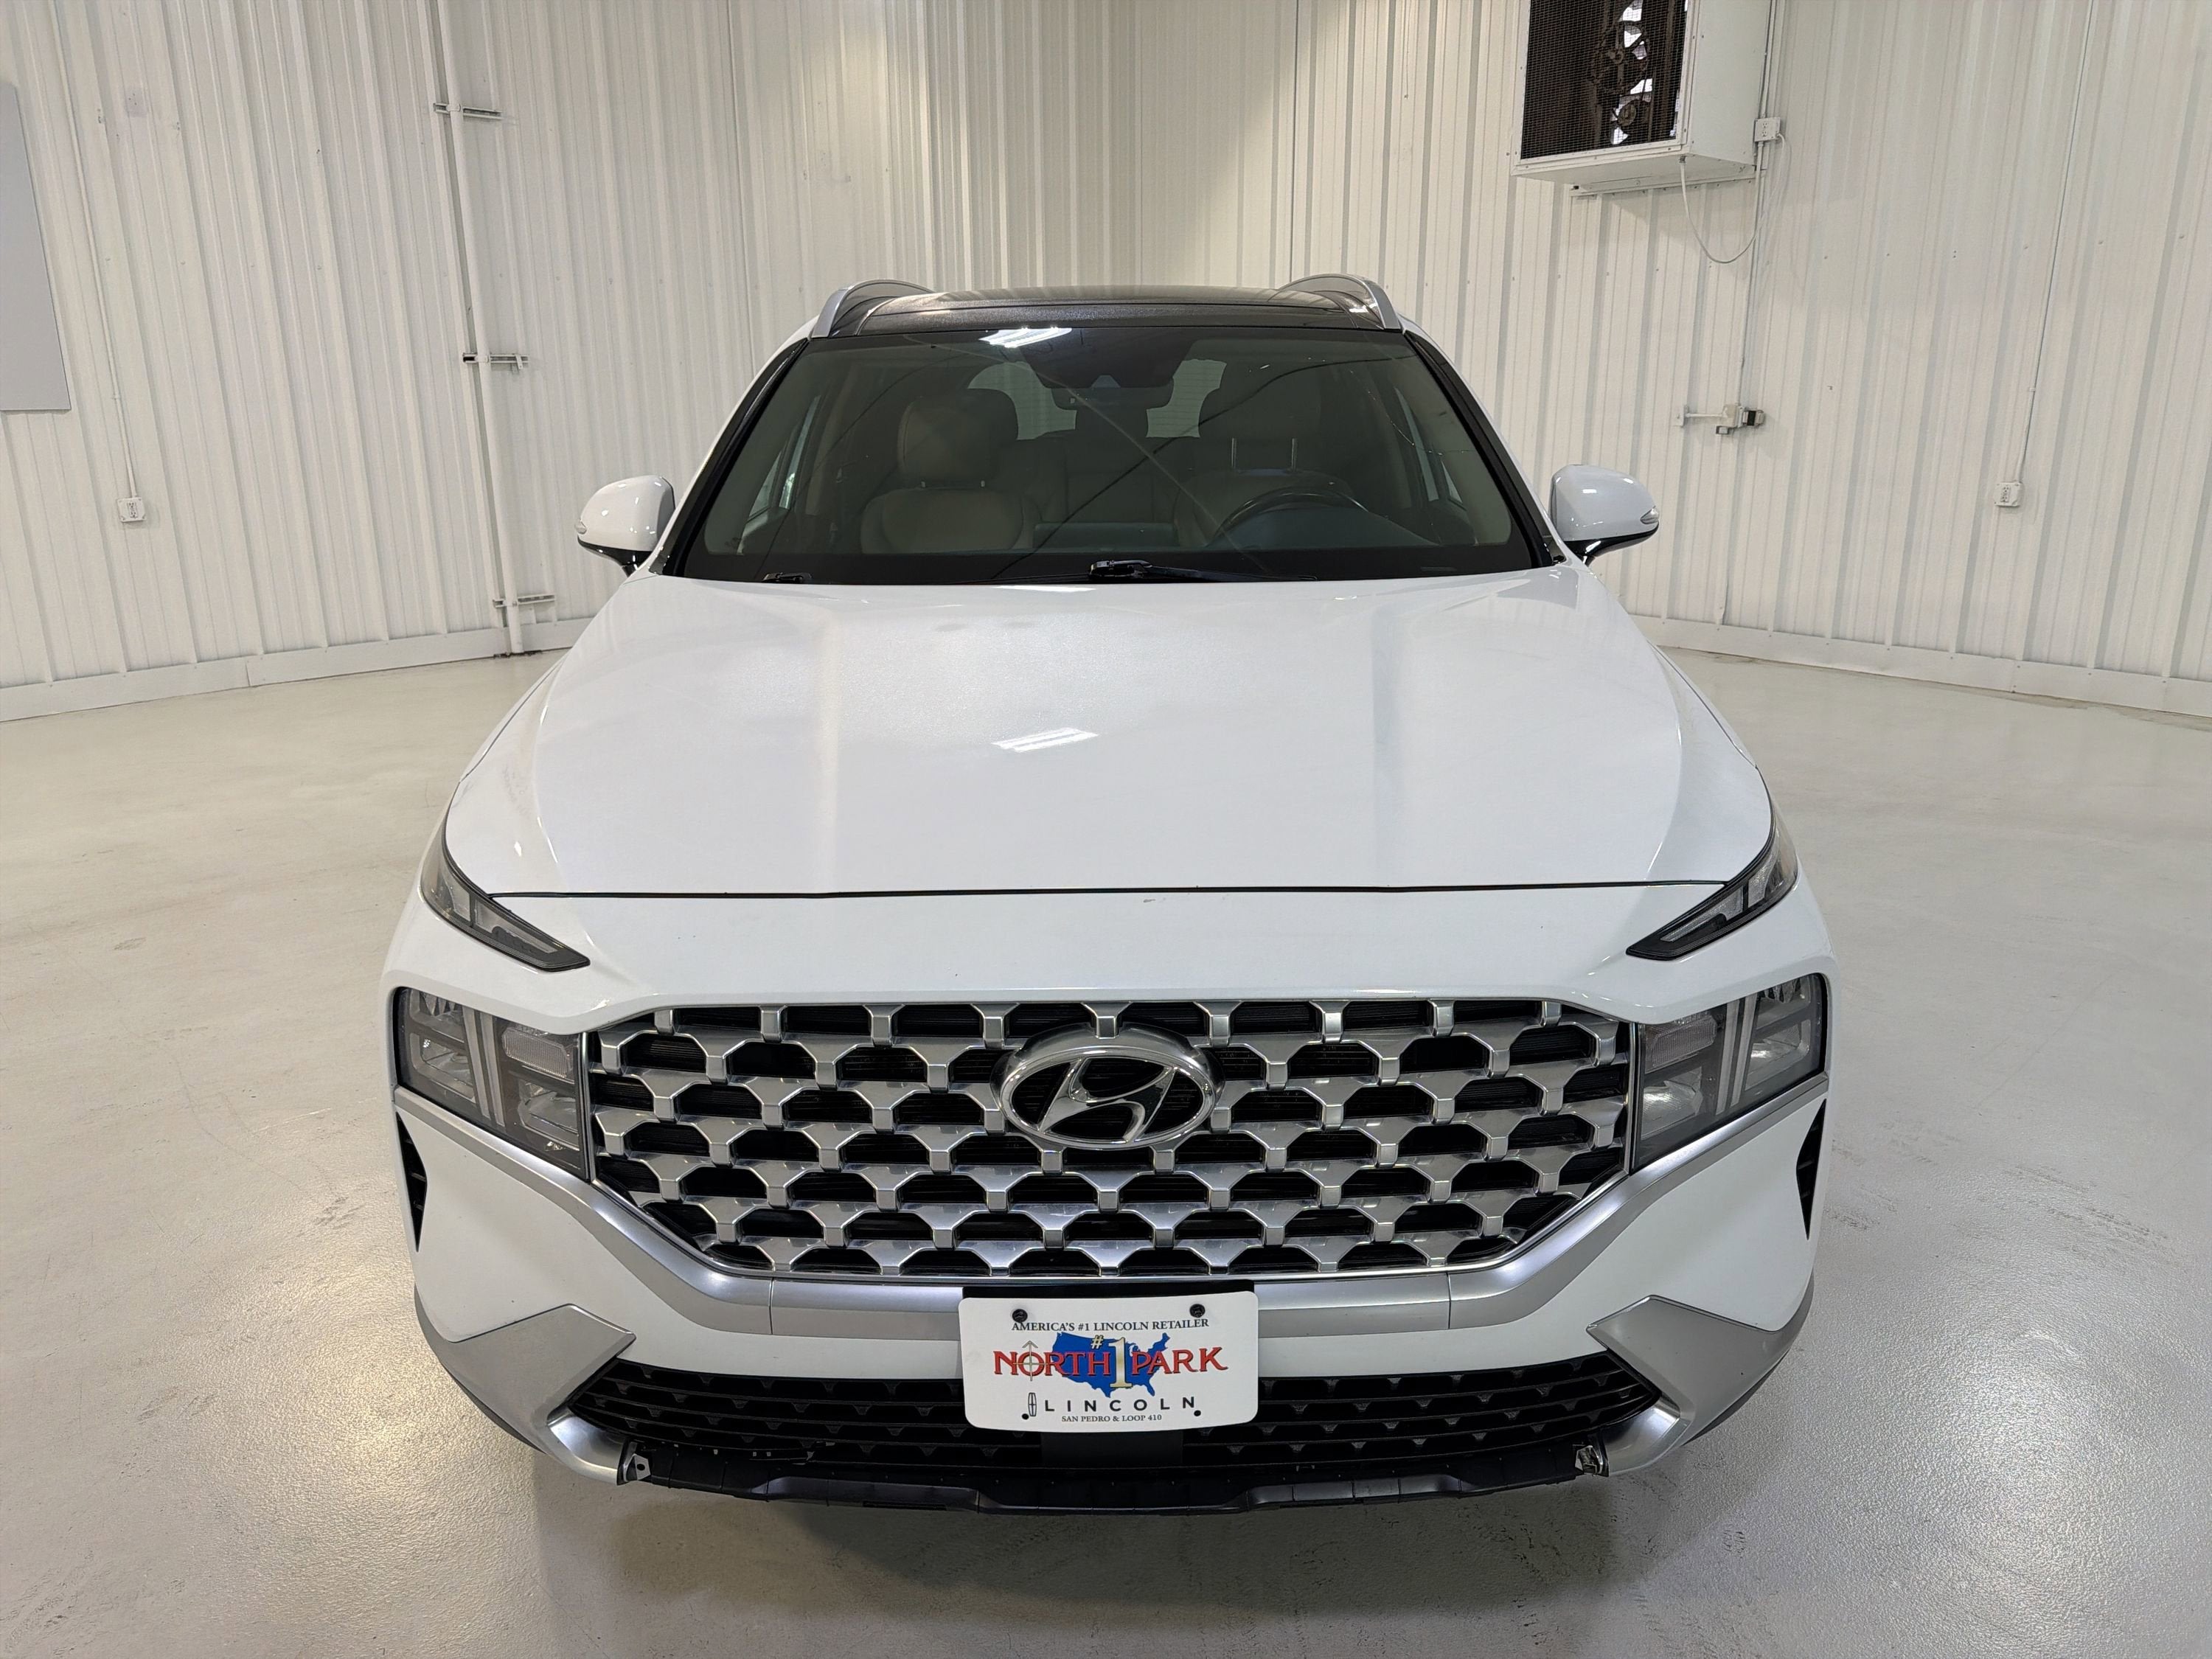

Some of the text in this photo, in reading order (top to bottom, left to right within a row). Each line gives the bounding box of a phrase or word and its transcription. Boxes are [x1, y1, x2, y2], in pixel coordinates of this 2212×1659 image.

[1012, 1318, 1209, 1332] AMERICA'S #1 LINCOLN RETAILER
[993, 1346, 1229, 1377] NORTH PARK
[1044, 1396, 1194, 1412] LINCOLN
